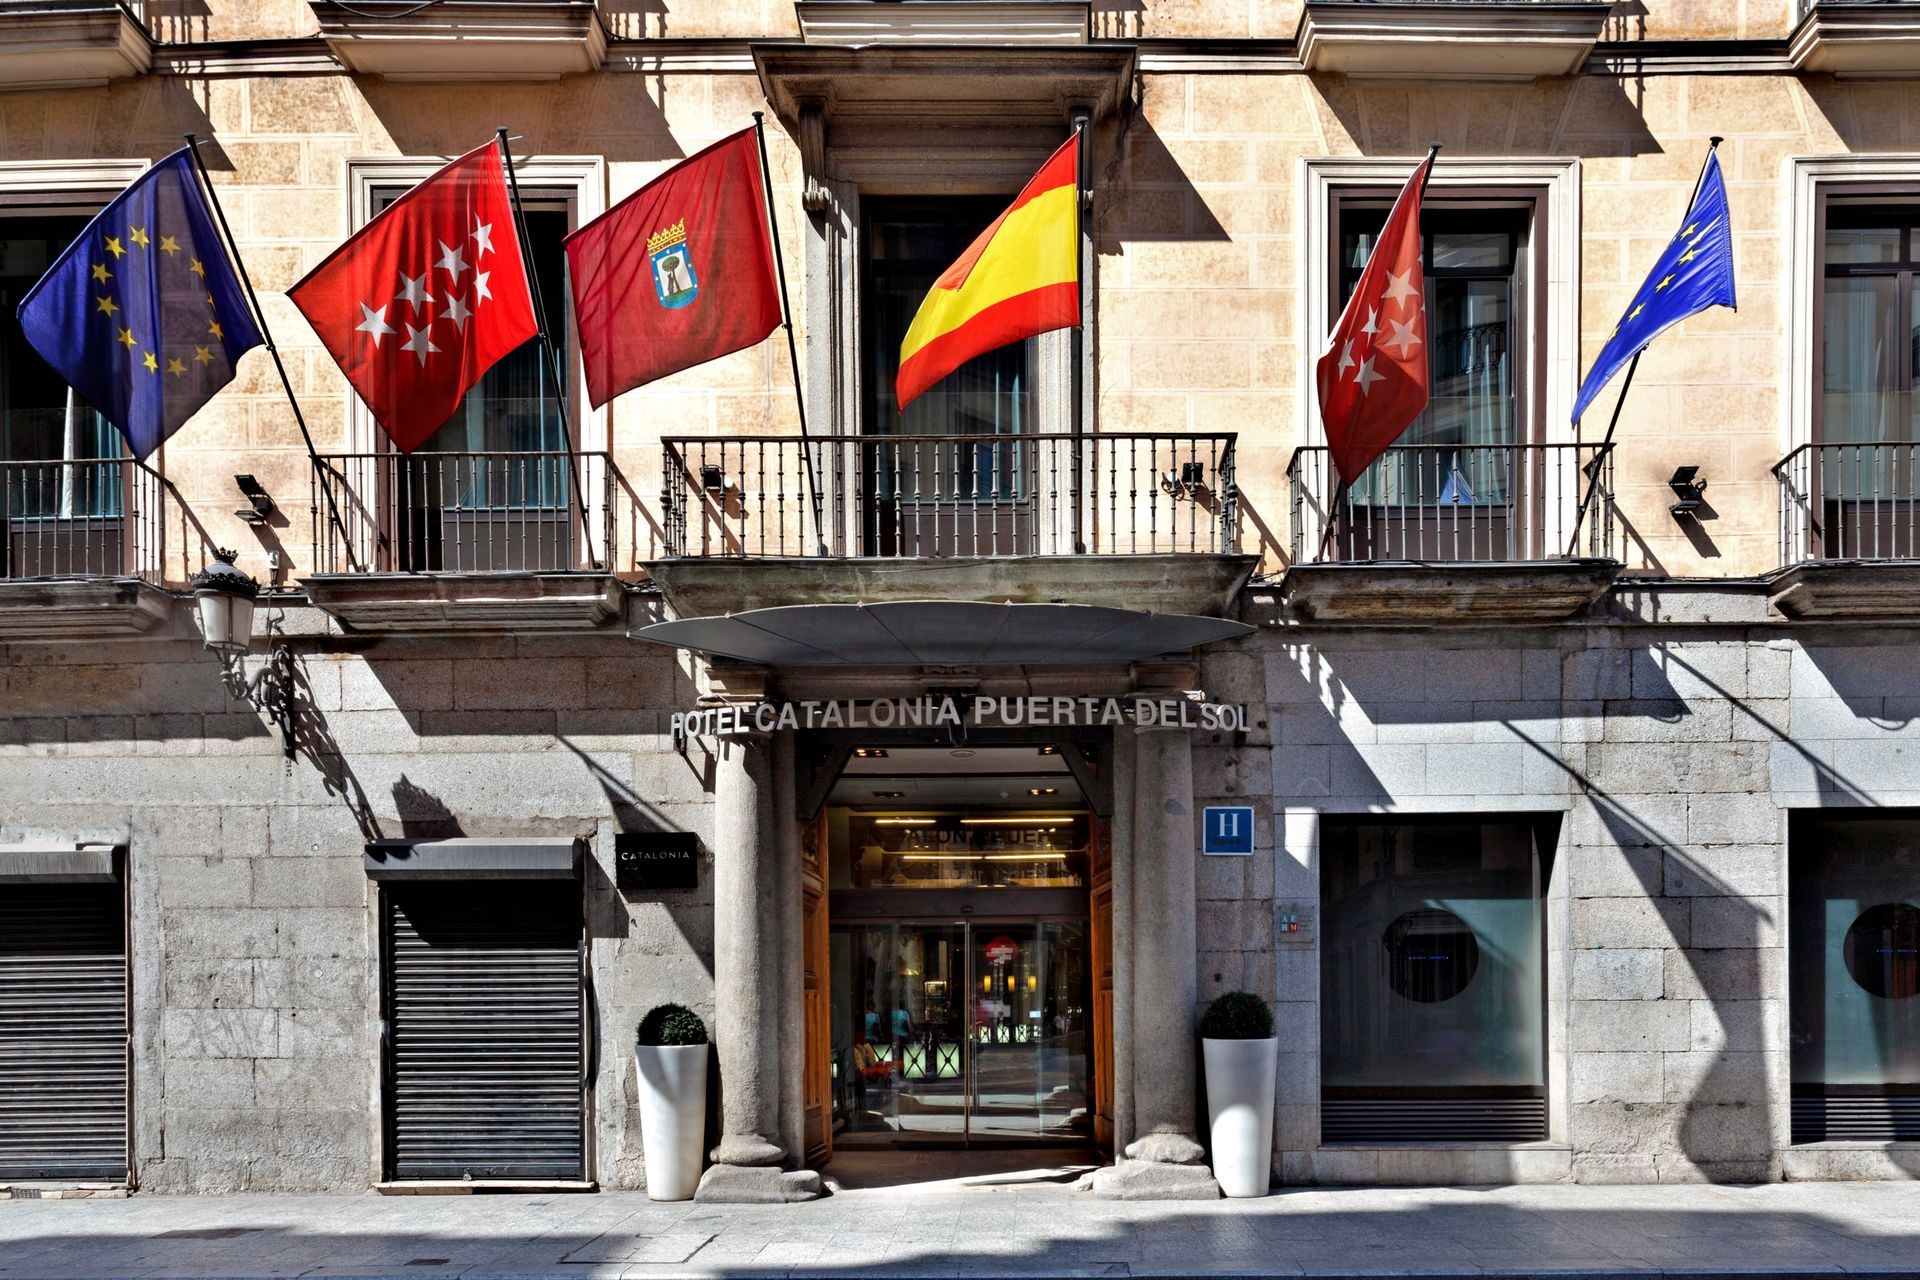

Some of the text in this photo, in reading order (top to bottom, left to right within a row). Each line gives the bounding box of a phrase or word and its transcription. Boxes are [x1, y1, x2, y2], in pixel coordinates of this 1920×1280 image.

[670, 696, 1252, 739] HOTEL CATALONIA PUERTA DEL SOL
[1217, 813, 1239, 837] H
[621, 851, 690, 861] CATALONIA
